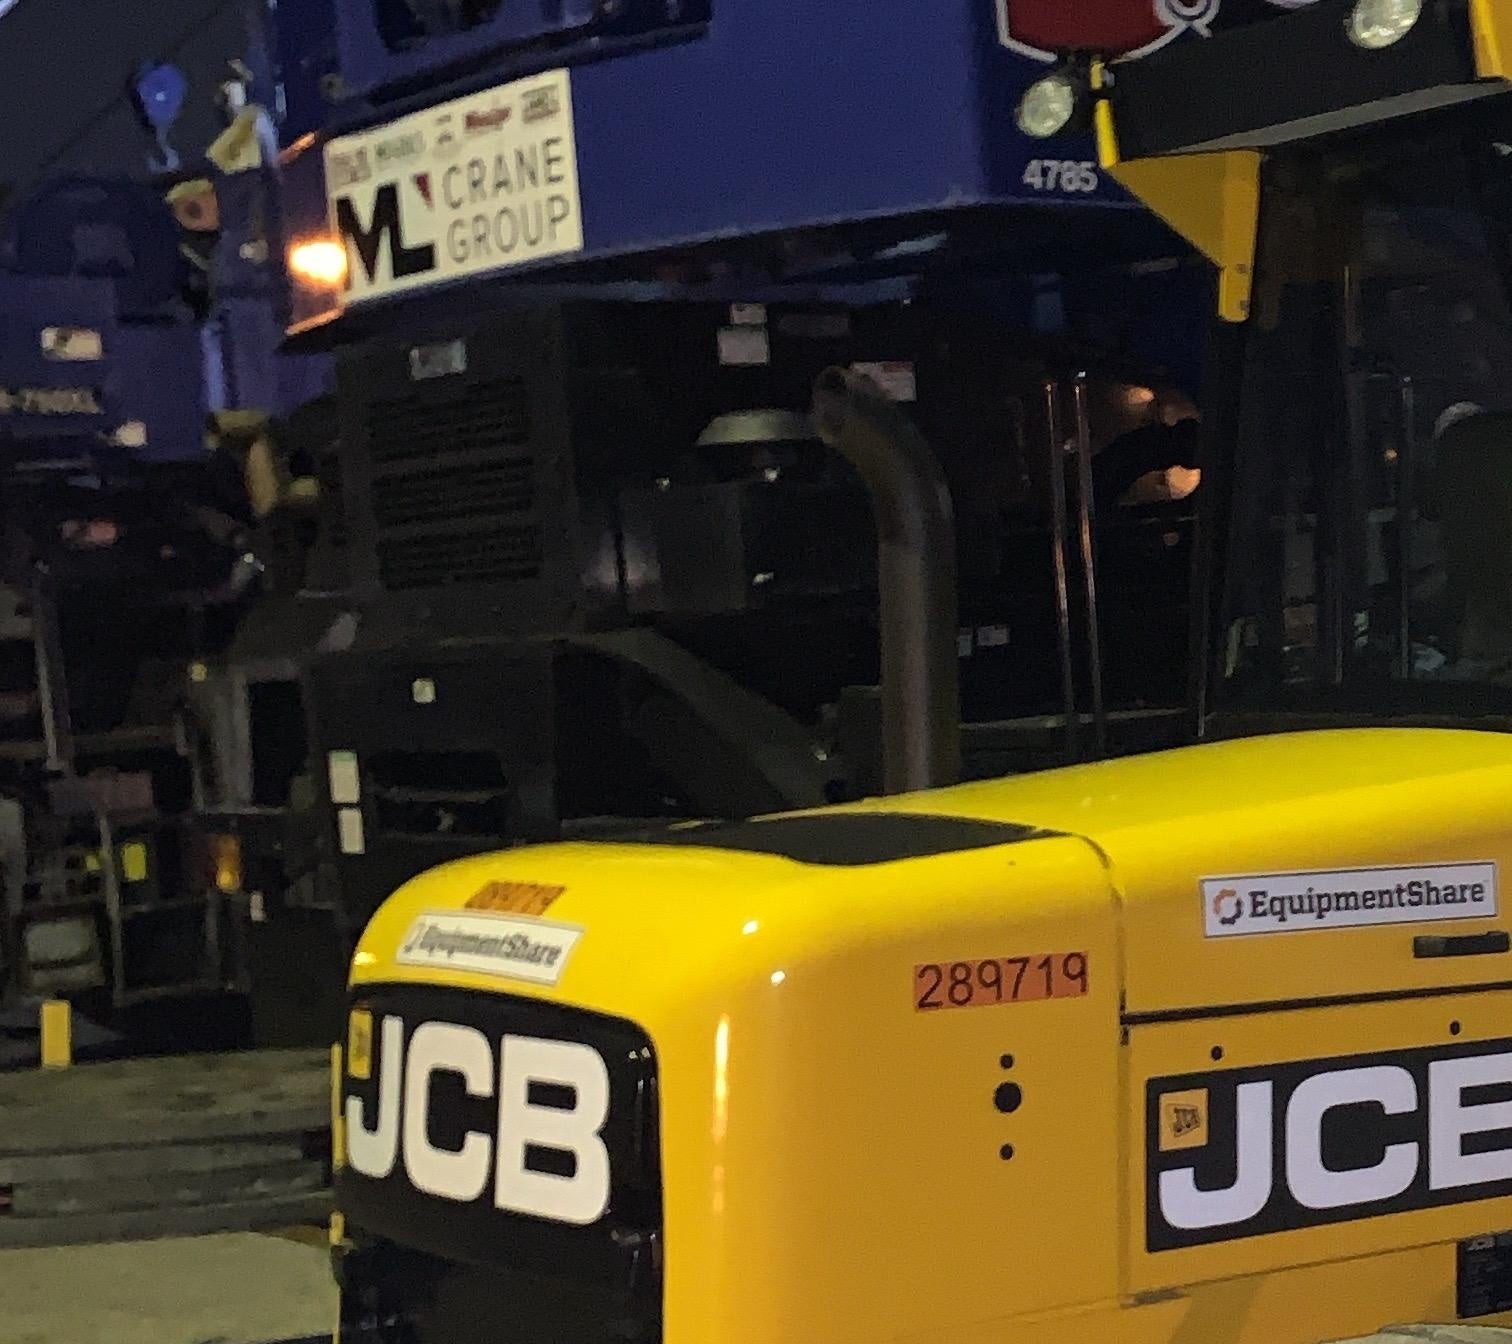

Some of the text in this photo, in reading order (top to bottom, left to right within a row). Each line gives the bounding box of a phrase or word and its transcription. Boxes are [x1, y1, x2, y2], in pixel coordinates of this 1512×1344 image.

[441, 136, 563, 210] CRANE
[1021, 159, 1099, 192] 4785
[446, 194, 570, 264] GROUP
[1248, 880, 1485, 922] EquipmentShare
[917, 952, 1088, 1009] 289719
[346, 1014, 611, 1226] JCB
